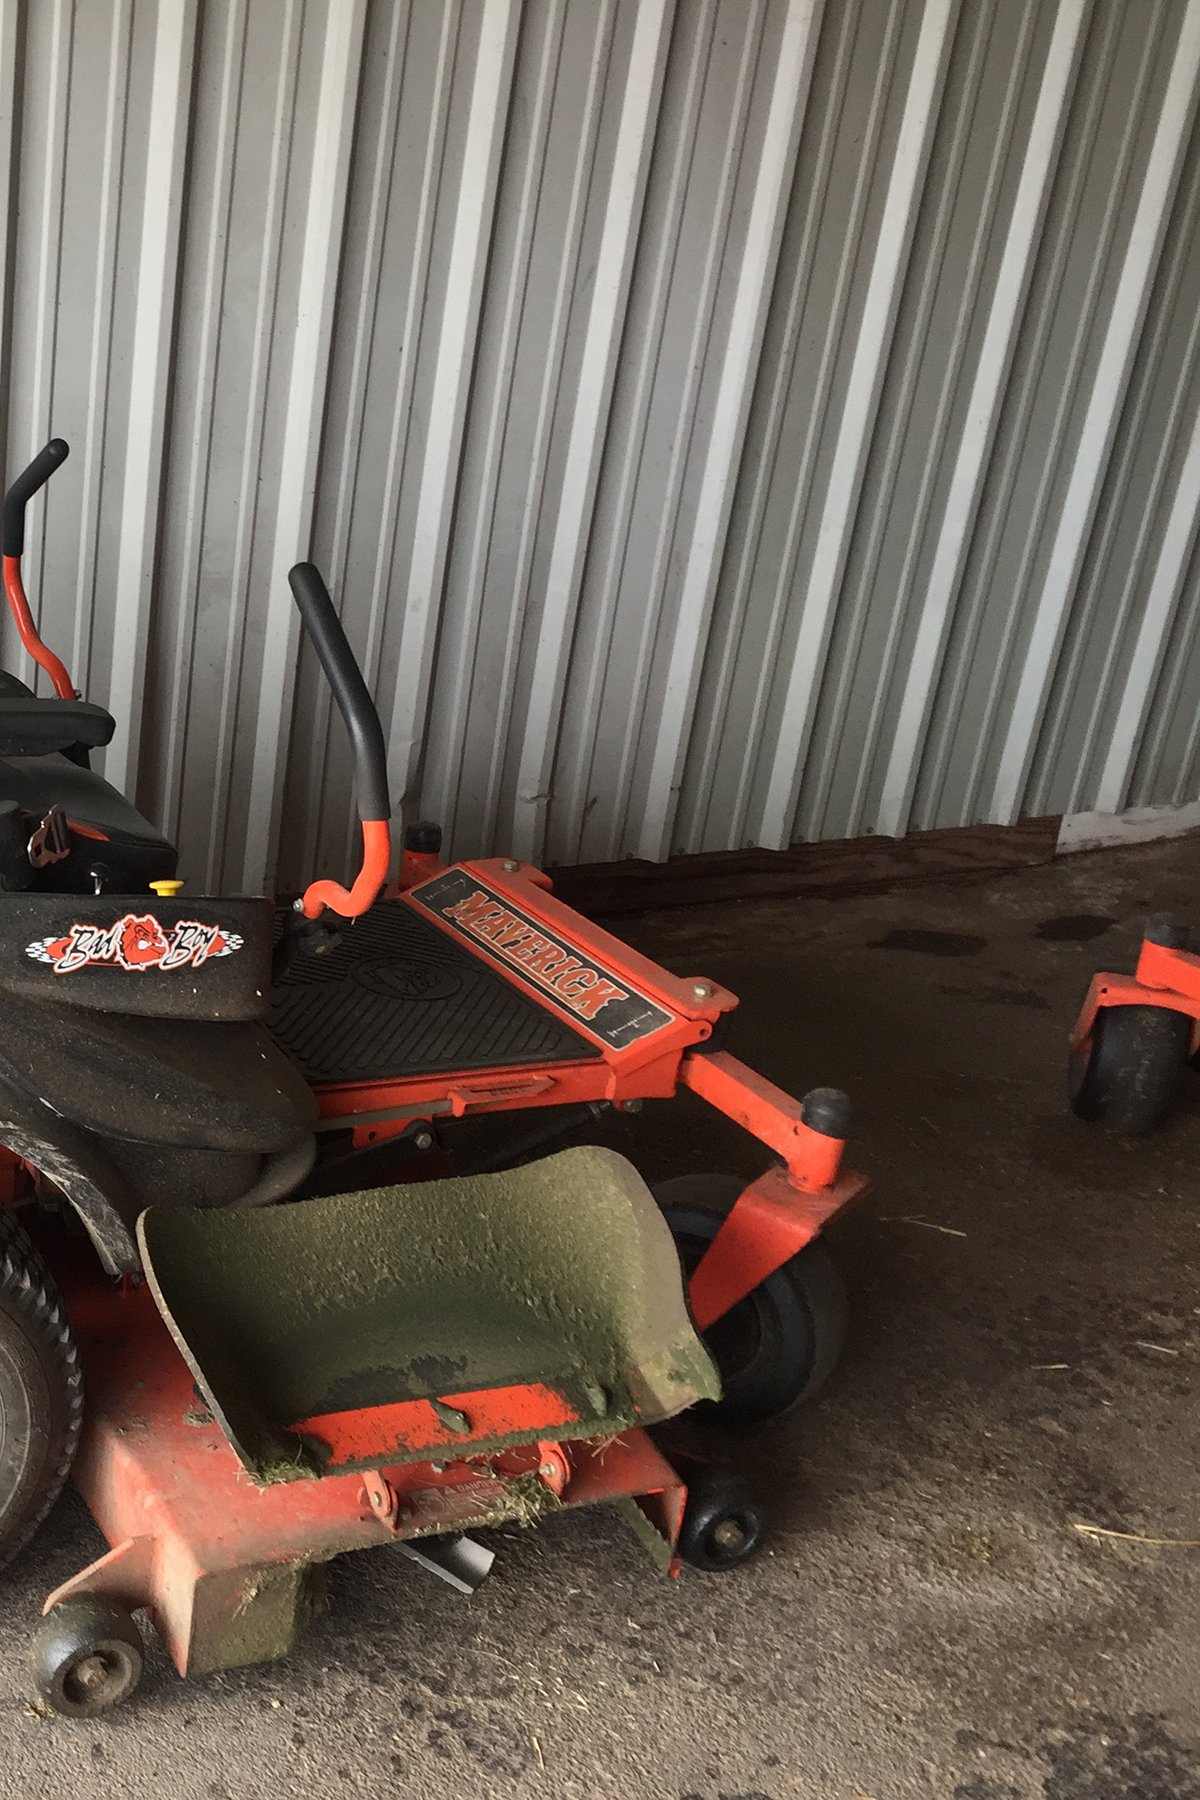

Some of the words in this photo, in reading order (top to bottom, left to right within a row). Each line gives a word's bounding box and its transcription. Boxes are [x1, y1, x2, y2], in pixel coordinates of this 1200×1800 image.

[53, 922, 123, 973] Bad
[159, 919, 220, 972] Boy
[442, 890, 629, 1021] MAVERICK
